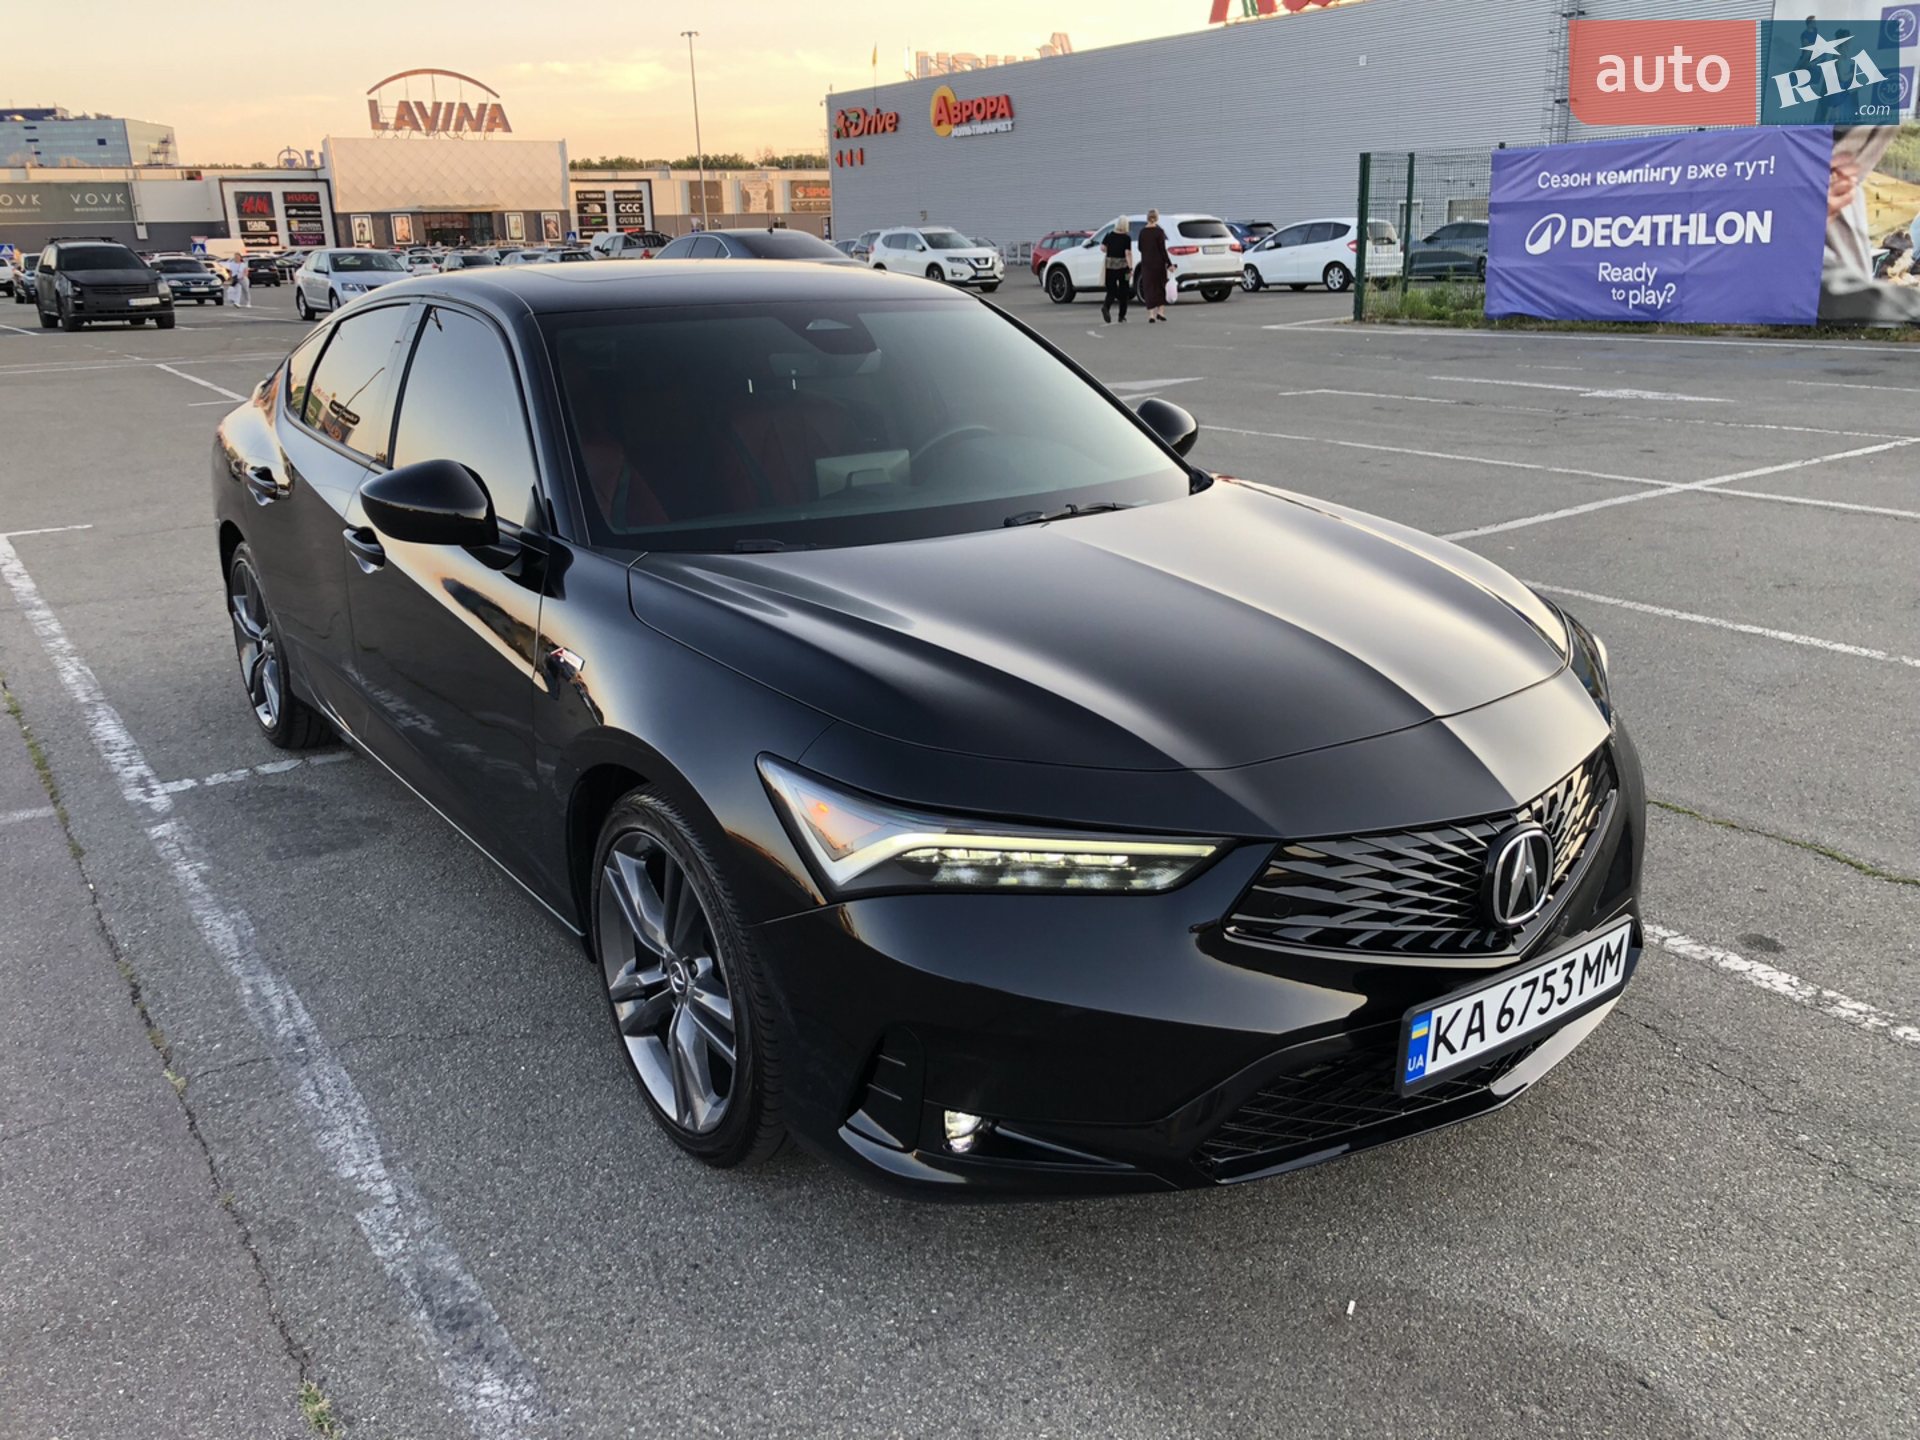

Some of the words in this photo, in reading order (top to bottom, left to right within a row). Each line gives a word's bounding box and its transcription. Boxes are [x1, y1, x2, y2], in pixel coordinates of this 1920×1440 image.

[1895, 18, 1905, 32] 2
[368, 99, 512, 133] LAVINA
[932, 94, 1013, 127] АВРОРА
[1537, 171, 1591, 189] Сезон
[1596, 163, 1682, 186] кемпінгу
[1687, 161, 1728, 180] вже
[1734, 155, 1776, 181] тут!
[70, 192, 126, 205] VOVK
[286, 194, 316, 202] HUGO
[619, 203, 640, 213] CCC
[618, 216, 643, 224] GUESS
[1571, 210, 1773, 249] DECATHLON
[1598, 262, 1658, 284] Ready
[1611, 286, 1626, 302] to
[1628, 283, 1676, 309] play?
[1431, 1000, 1485, 1063] KA
[1496, 958, 1577, 1034] 6753
[1578, 932, 1626, 997] MM
[1407, 1054, 1425, 1073] UA
